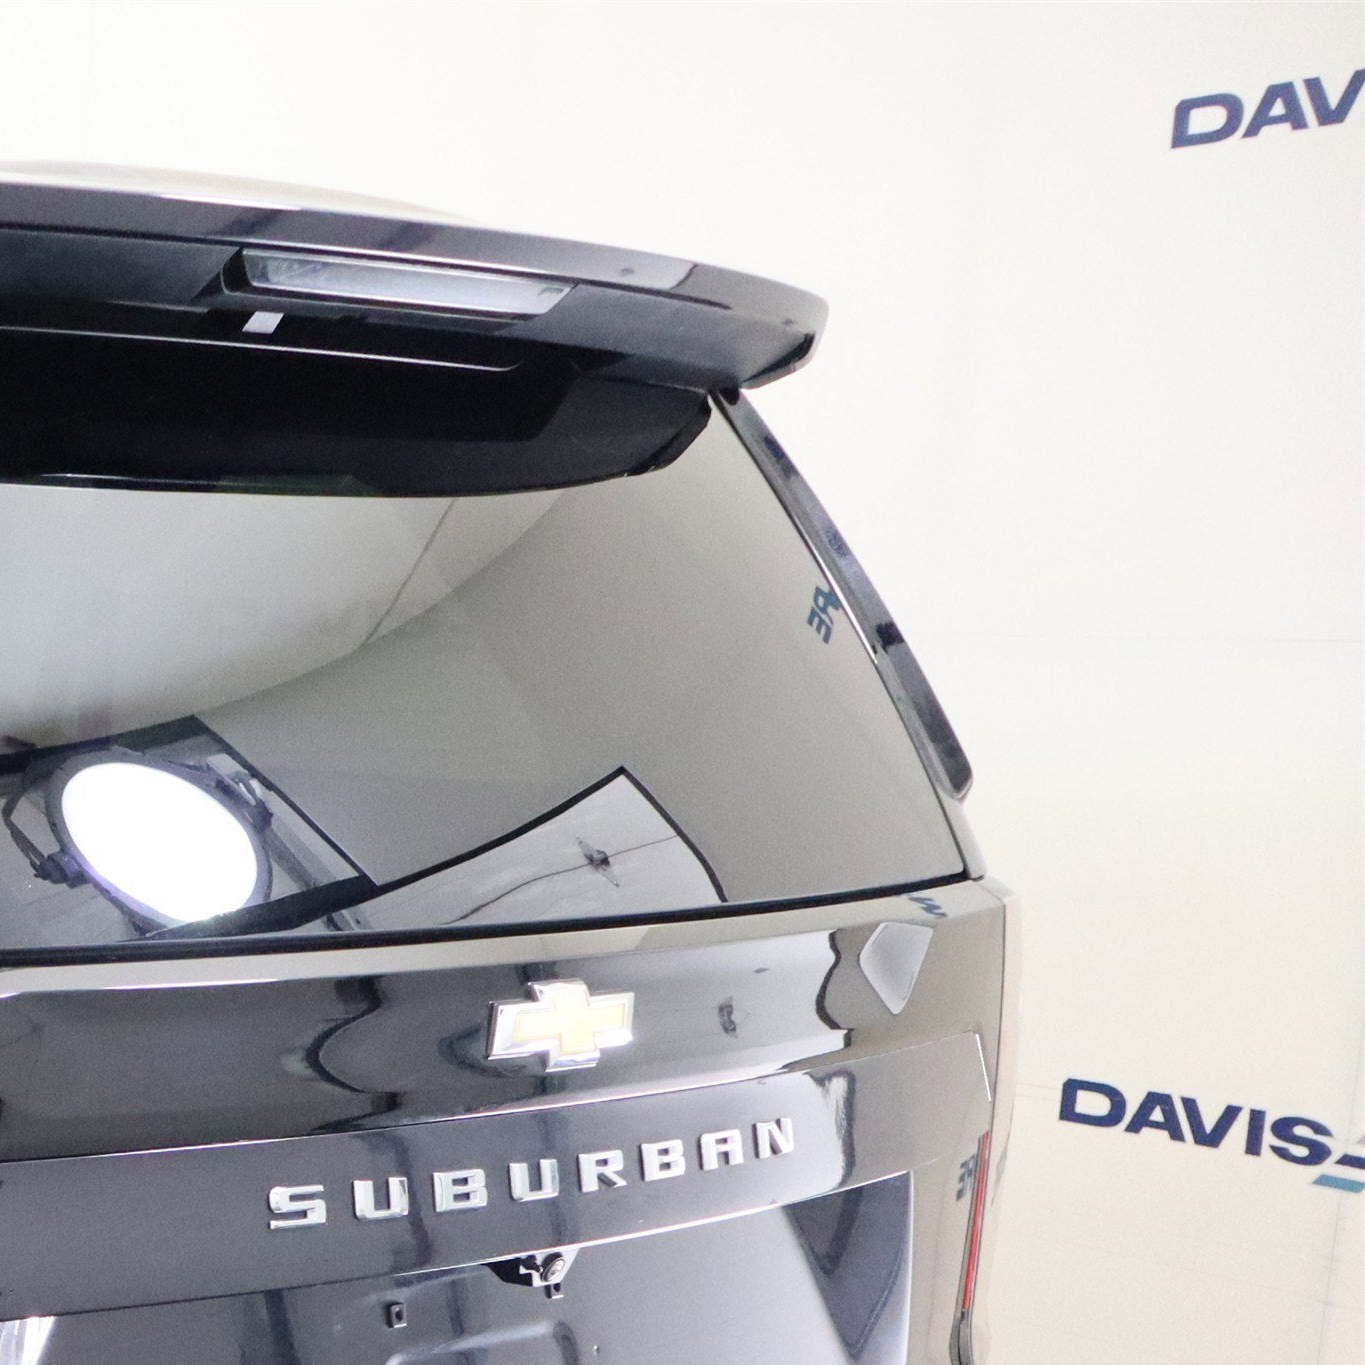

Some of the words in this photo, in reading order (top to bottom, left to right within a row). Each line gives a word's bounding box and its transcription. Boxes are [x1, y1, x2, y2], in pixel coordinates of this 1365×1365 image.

[1170, 68, 1365, 149] DAV
[1058, 1077, 1337, 1167] DAVIS
[269, 1117, 795, 1230] SUBURBAN
